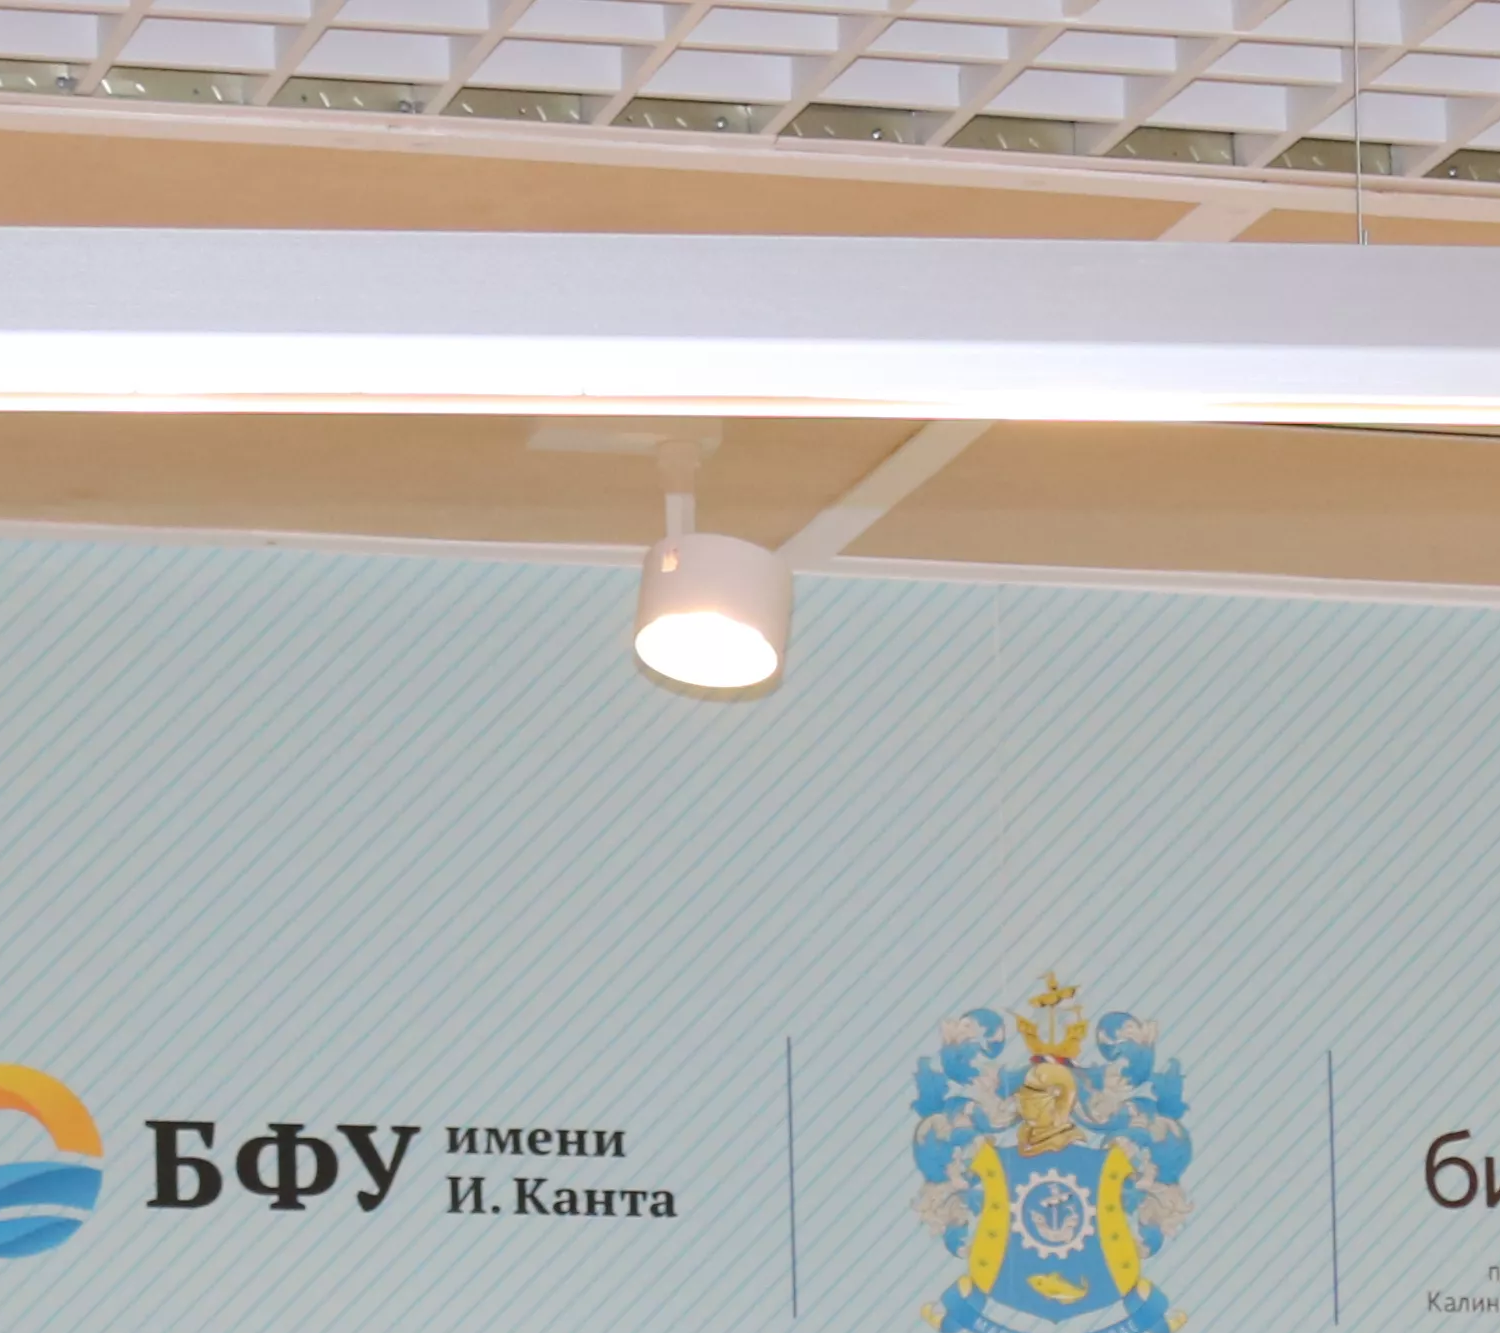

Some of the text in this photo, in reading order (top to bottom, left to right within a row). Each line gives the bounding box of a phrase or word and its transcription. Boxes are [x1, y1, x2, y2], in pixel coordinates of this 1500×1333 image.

[445, 1125, 626, 1159] имени
[143, 1119, 422, 1214] БФУ
[446, 1175, 678, 1219] И. Канта
